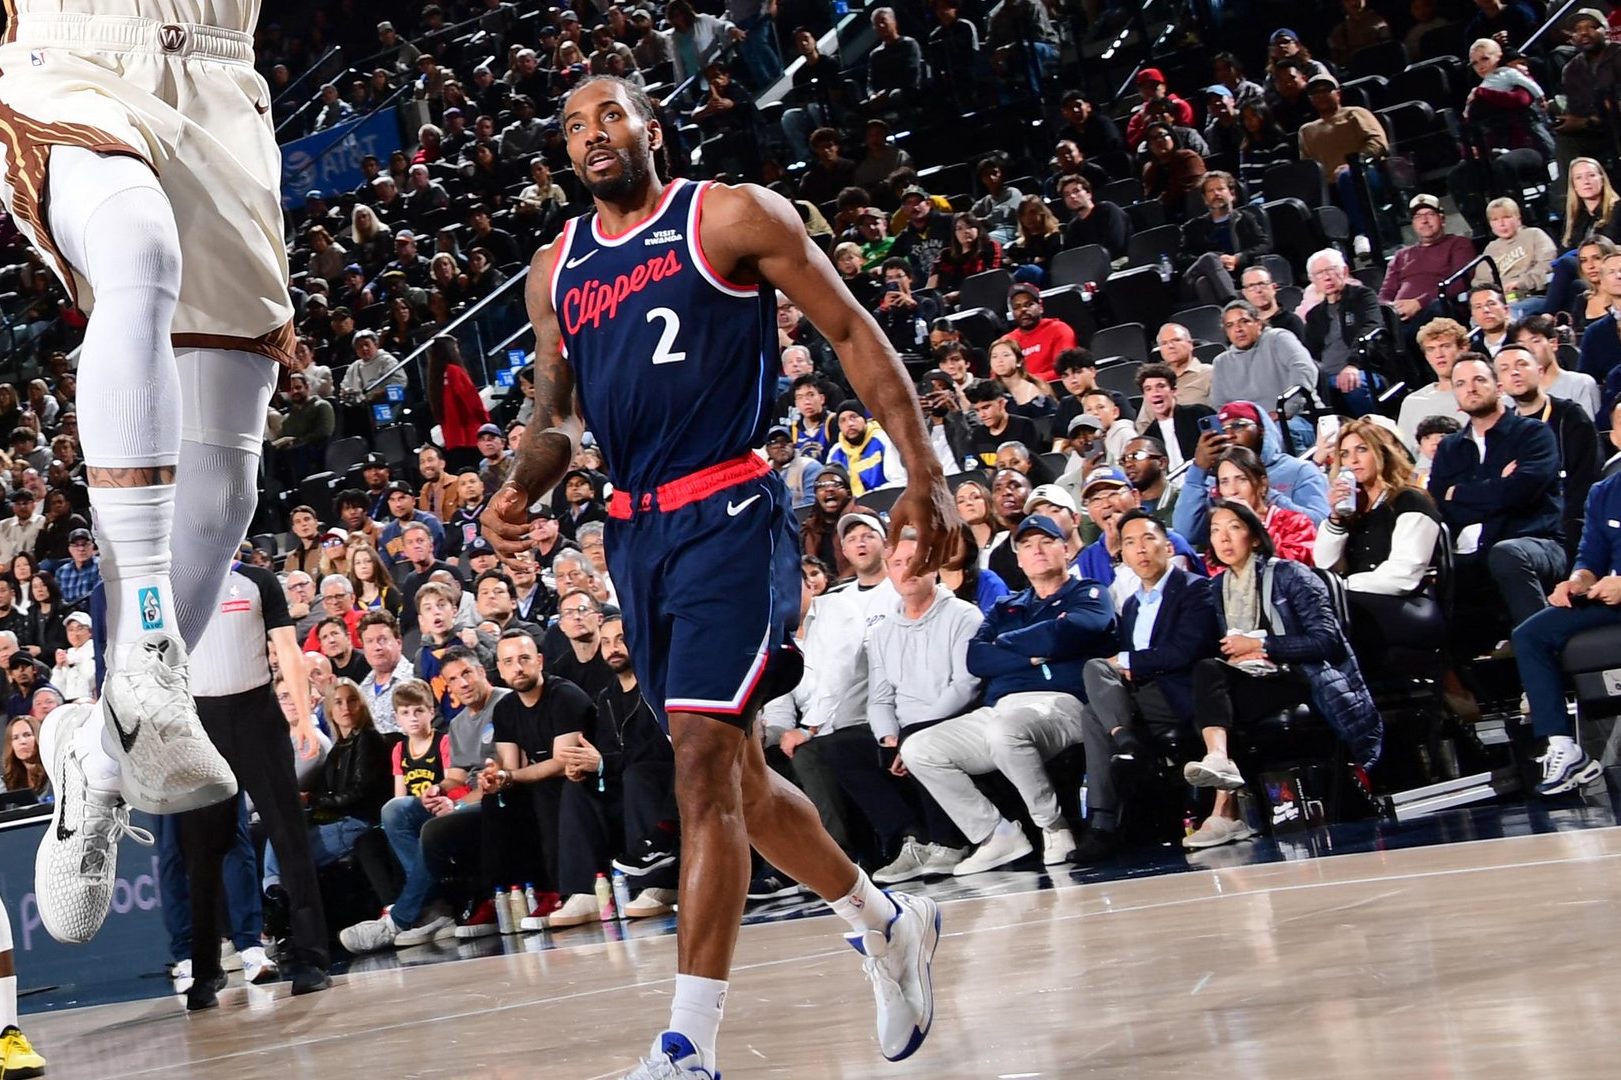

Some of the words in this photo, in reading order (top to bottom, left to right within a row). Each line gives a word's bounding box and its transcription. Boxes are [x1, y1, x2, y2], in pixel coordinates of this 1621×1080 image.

[644, 233, 683, 246] RWANDA
[652, 229, 676, 239] VISIT
[562, 248, 682, 336] Clippers
[646, 307, 686, 365] 2
